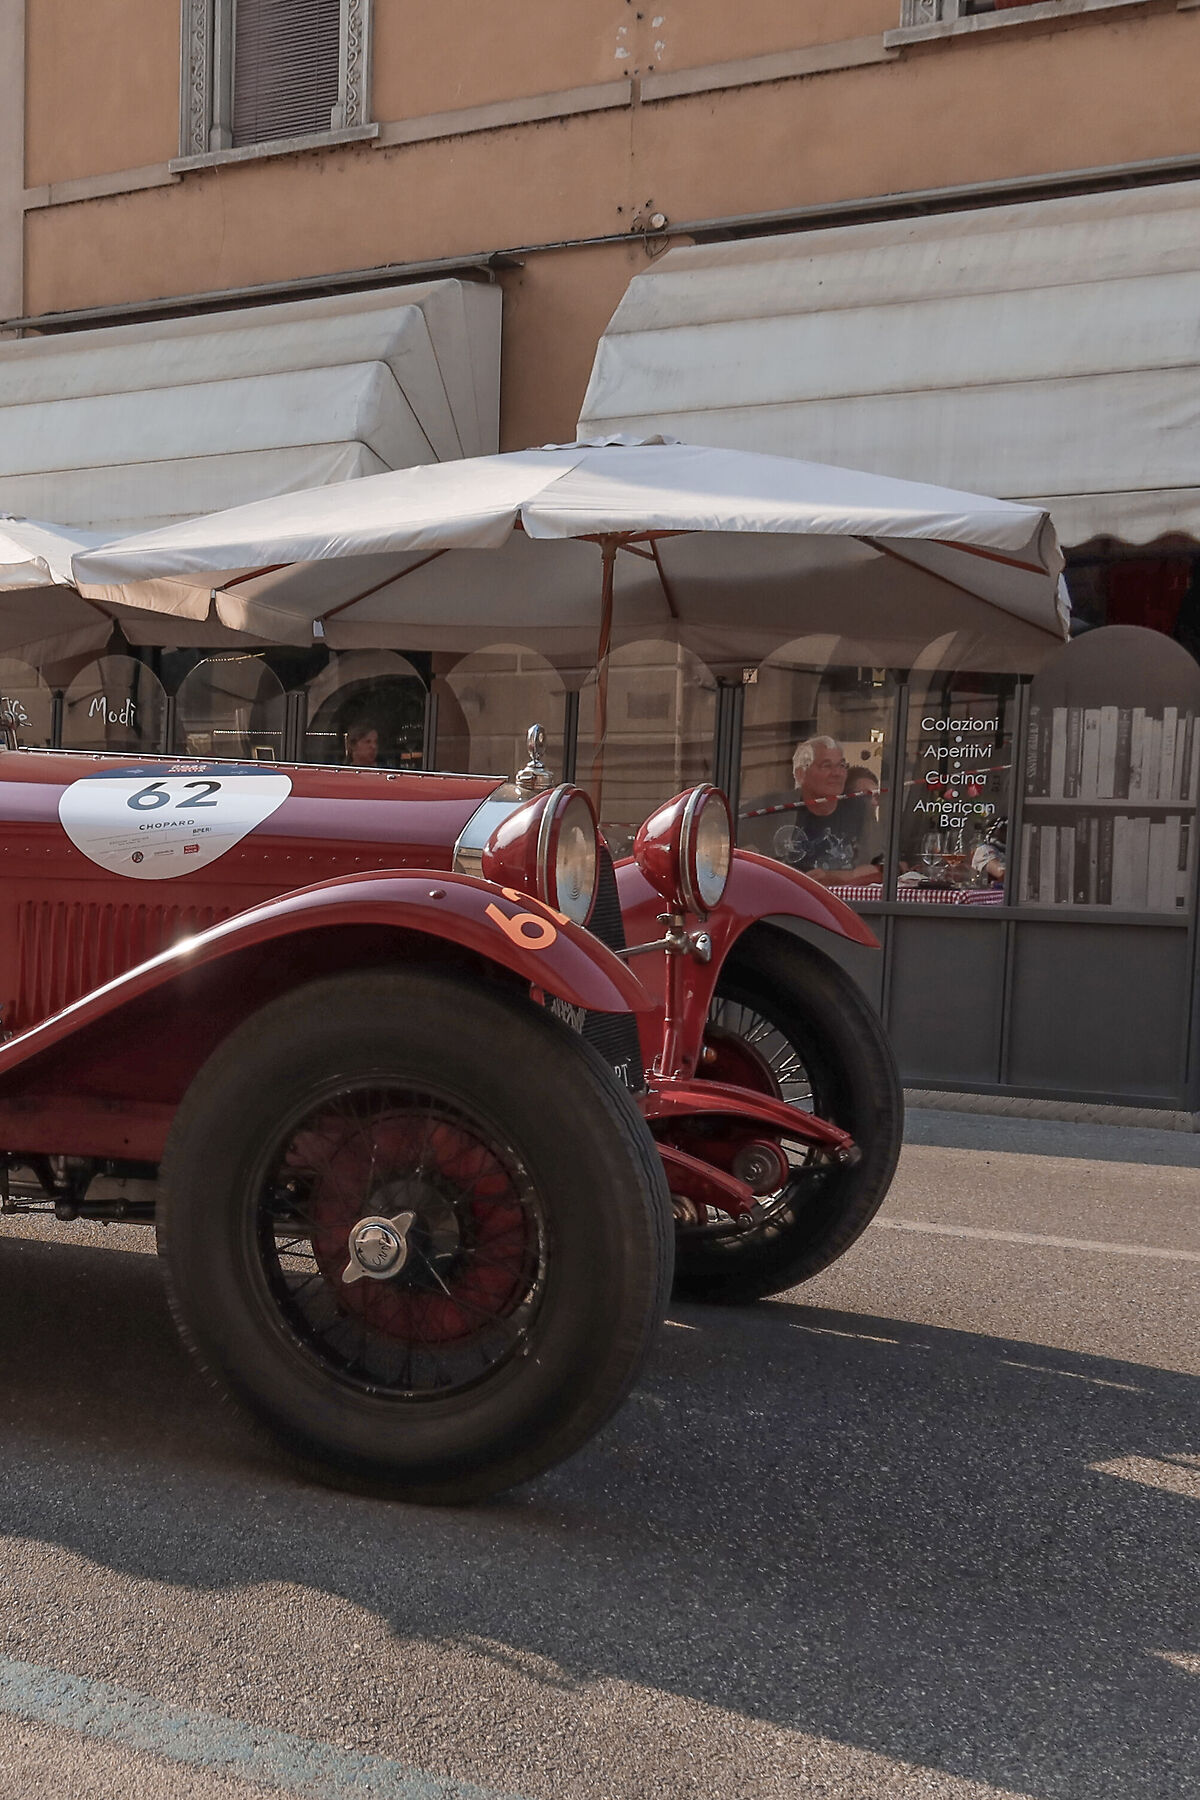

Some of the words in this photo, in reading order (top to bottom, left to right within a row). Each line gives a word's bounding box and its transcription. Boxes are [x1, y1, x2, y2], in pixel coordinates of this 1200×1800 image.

[921, 717, 1000, 731] Colazioni
[923, 744, 992, 760] Aperitivi
[925, 771, 987, 785] Cucina
[126, 780, 222, 811] 62
[913, 800, 995, 814] American
[139, 819, 195, 831] CHOPARD
[940, 814, 968, 828] Bar
